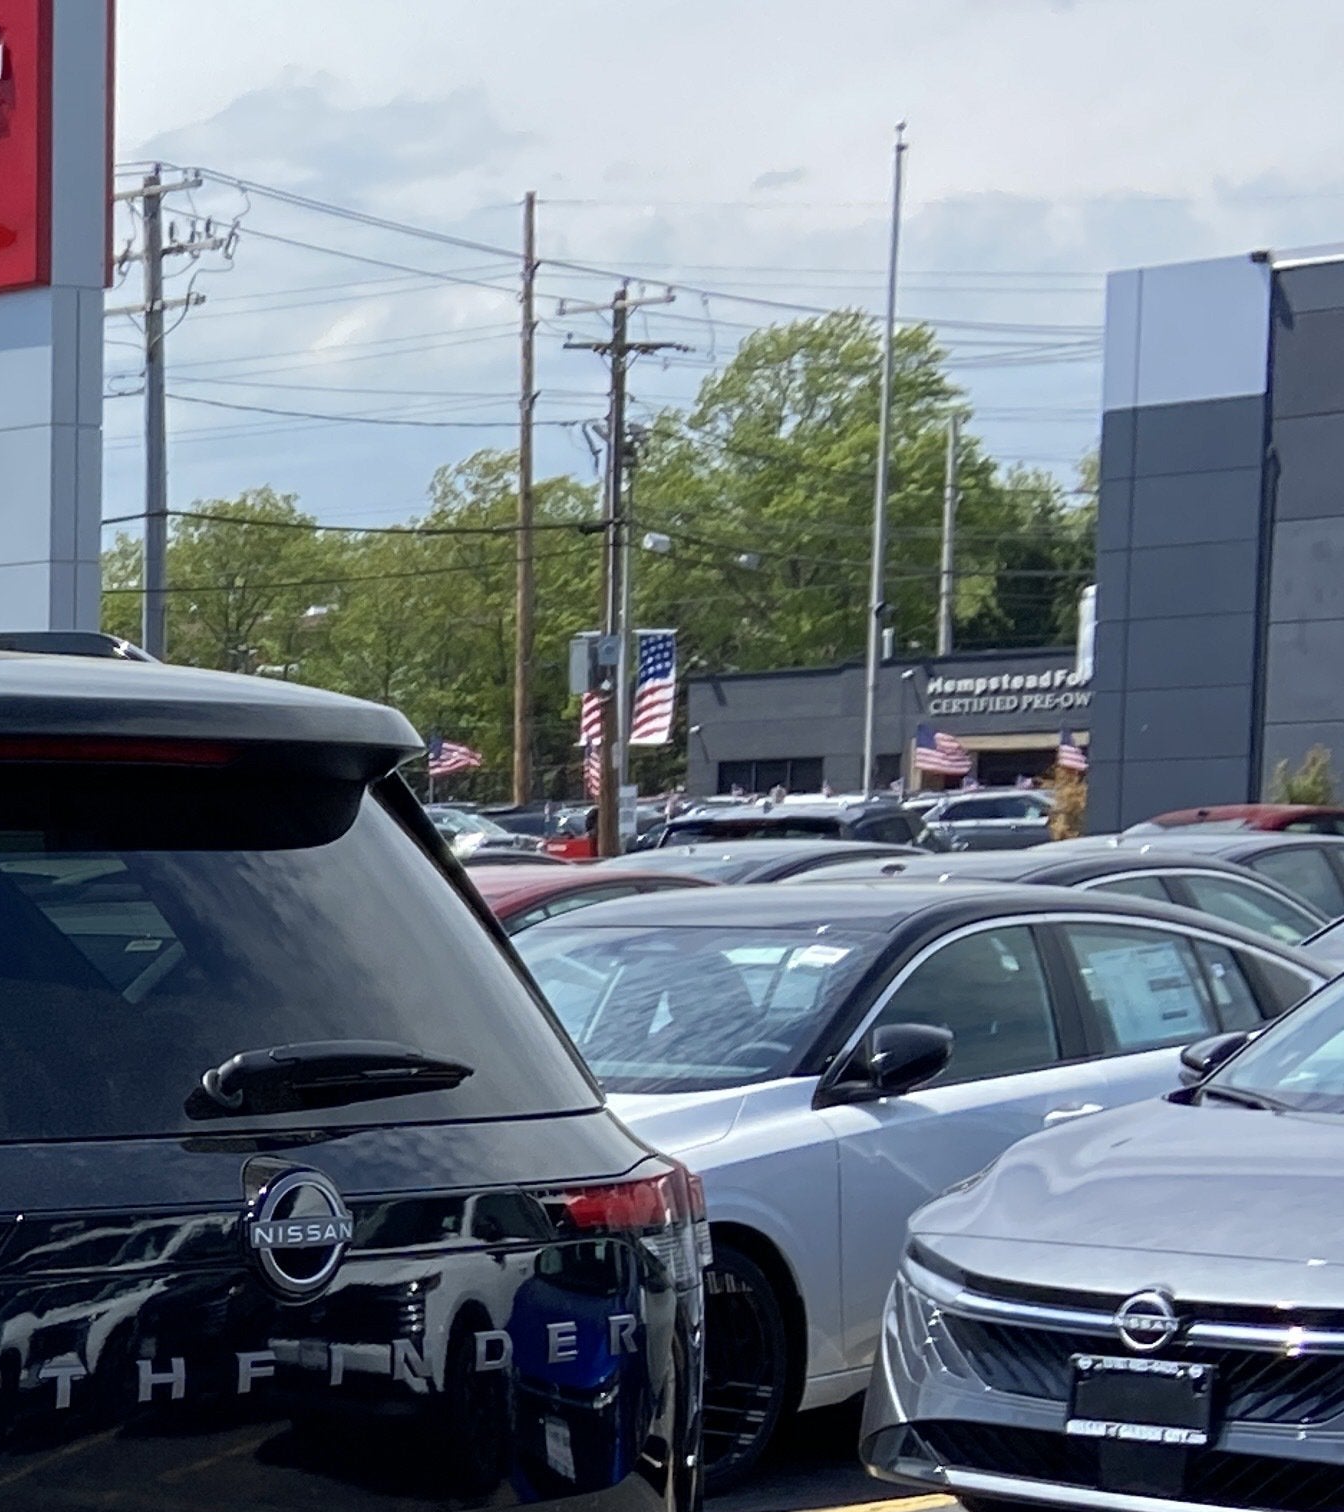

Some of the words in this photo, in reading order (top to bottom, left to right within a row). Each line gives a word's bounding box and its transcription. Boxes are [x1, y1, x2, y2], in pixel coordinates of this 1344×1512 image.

[927, 670, 1052, 695] Hempstead
[929, 696, 1018, 715] CERTIFIED
[254, 1222, 353, 1245] NISSAN
